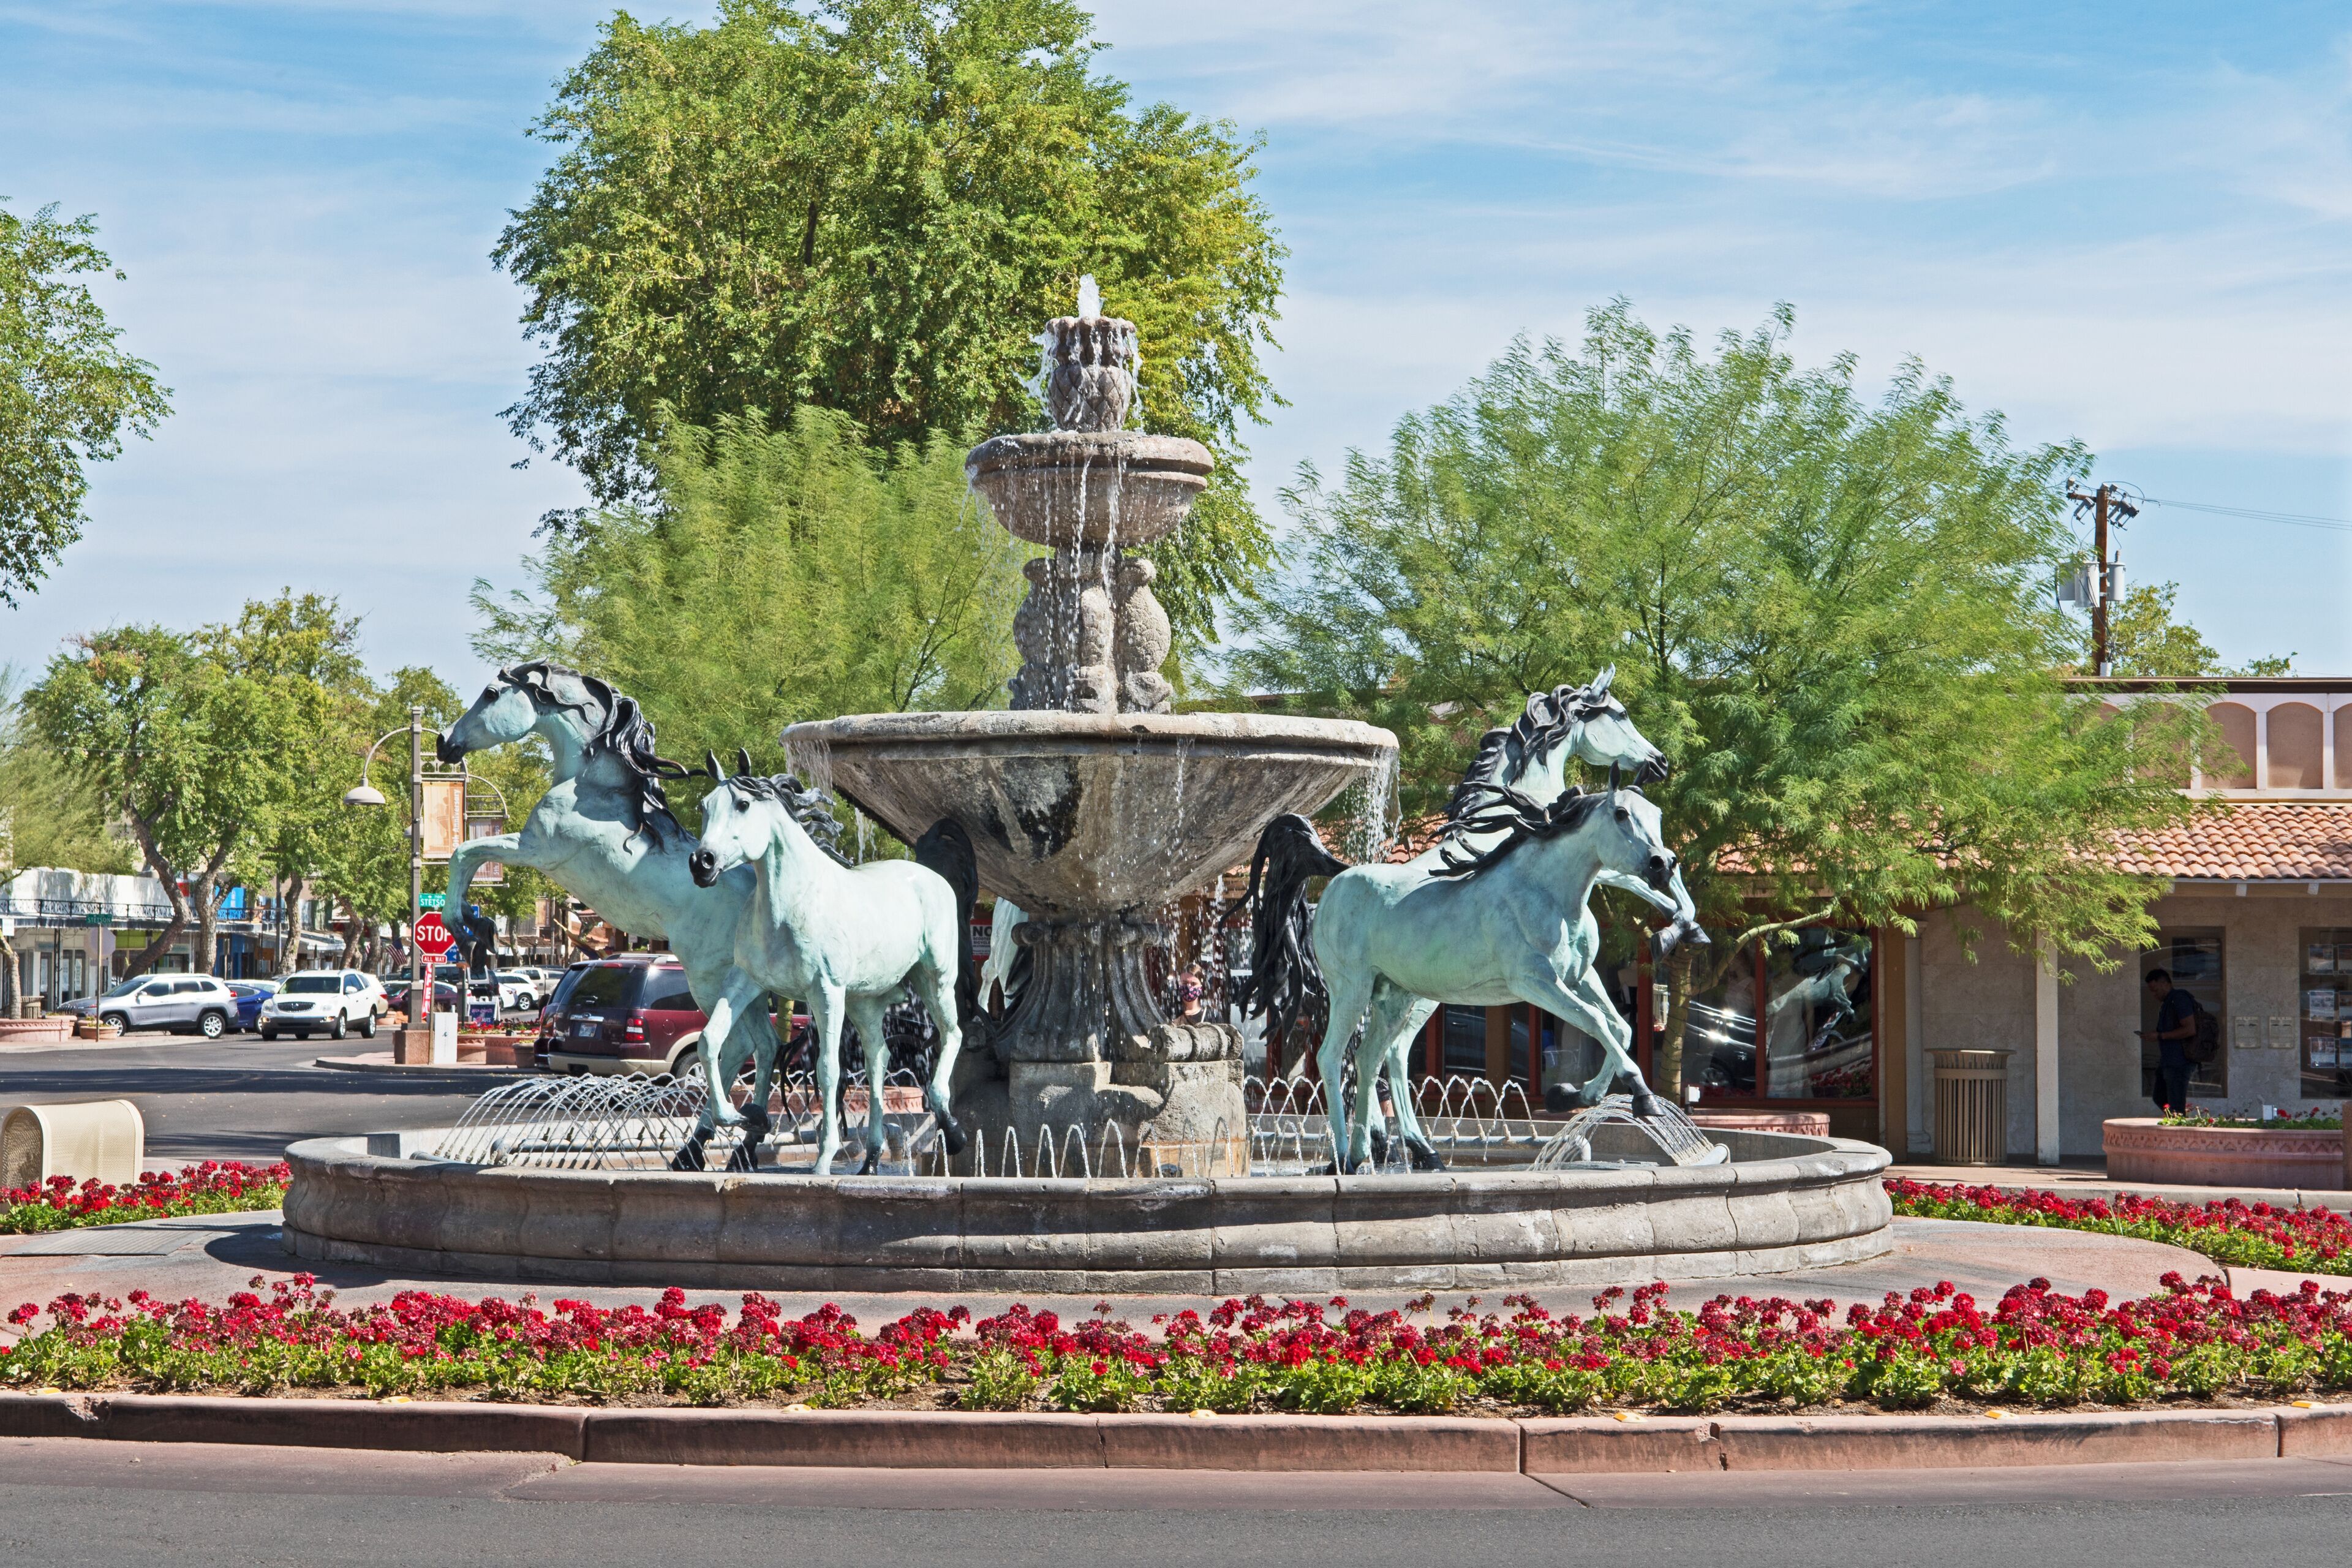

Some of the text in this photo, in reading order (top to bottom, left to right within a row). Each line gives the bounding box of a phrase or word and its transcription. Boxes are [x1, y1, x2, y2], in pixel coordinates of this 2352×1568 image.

[453, 789, 461, 833] Anniversary
[417, 925, 451, 942] STOP
[973, 926, 992, 937] NO
